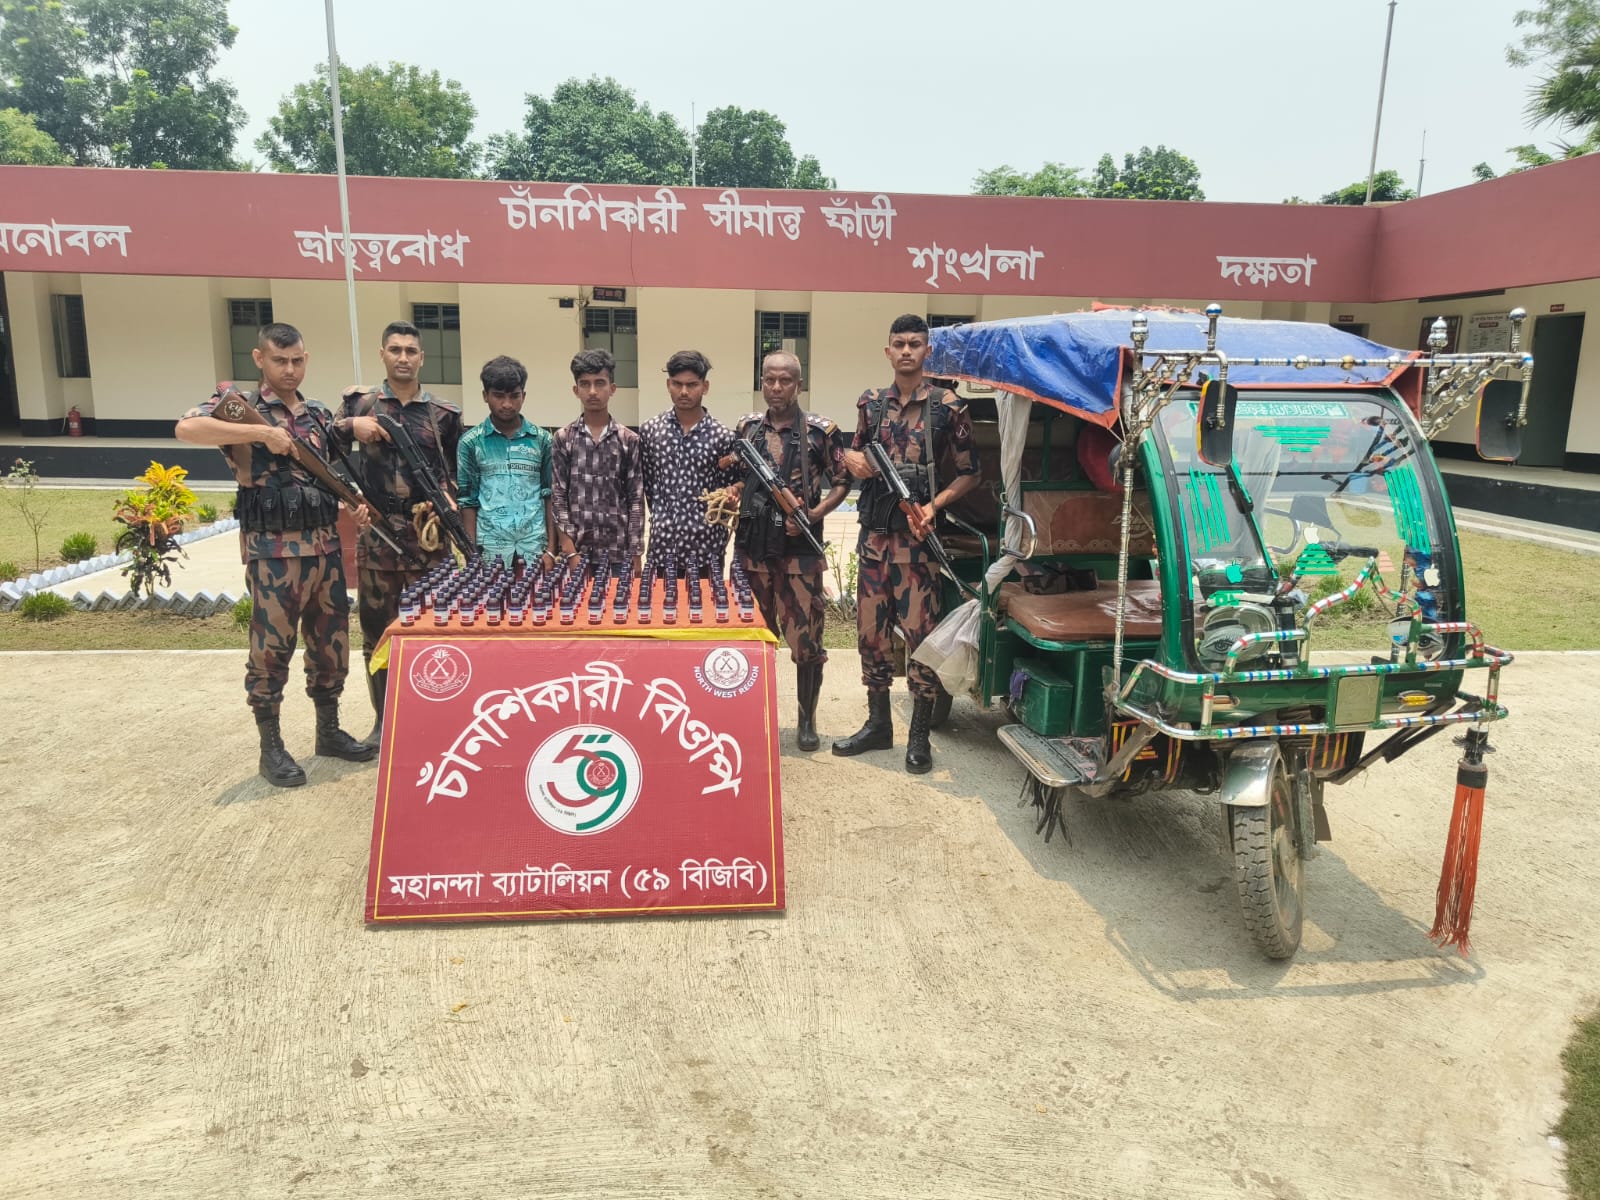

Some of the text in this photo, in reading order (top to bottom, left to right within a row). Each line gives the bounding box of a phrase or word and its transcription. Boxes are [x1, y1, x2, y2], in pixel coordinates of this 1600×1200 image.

[499, 183, 898, 247] চাঁনশিকারী সীমান্ত ফাঁড়ী
[906, 240, 1045, 288] শৃংখলা
[1215, 253, 1317, 288] দক্ষতা
[693, 665, 759, 698] NORTH WEST REGION
[416, 661, 742, 805] চাঁনশিকারী বিওপি
[388, 857, 768, 899] মহানন্দা ব্যাটালিয়ন (৫৯ বিজিবি)
